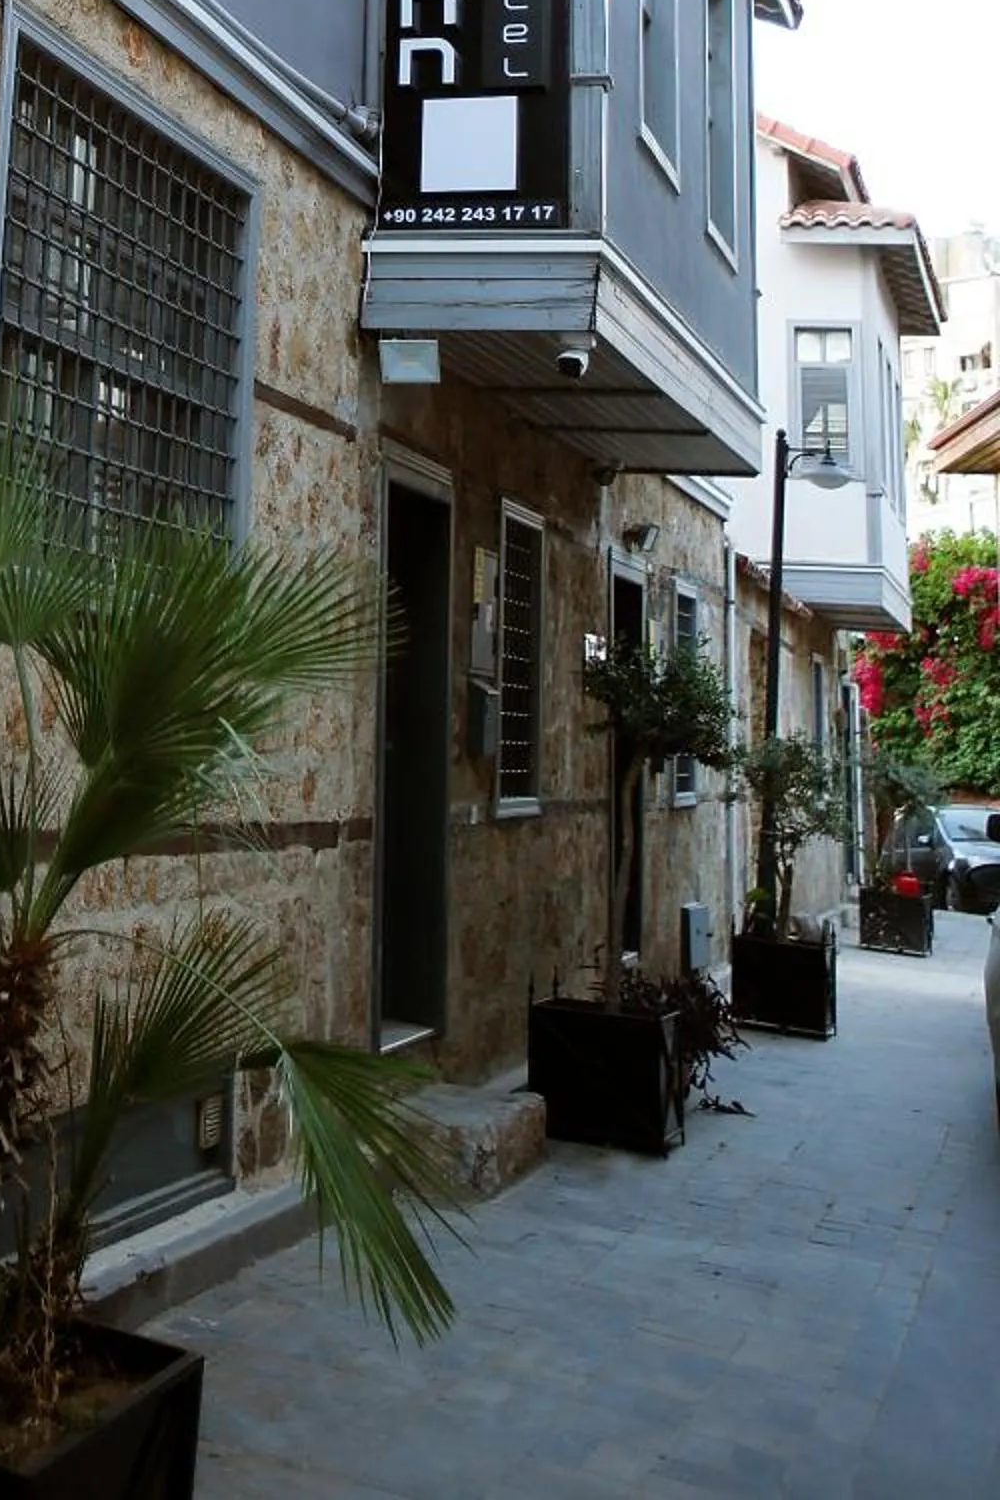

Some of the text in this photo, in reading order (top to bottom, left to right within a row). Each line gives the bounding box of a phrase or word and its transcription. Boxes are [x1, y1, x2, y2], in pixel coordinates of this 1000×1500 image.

[383, 205, 554, 223] +90 242 243 17 17
